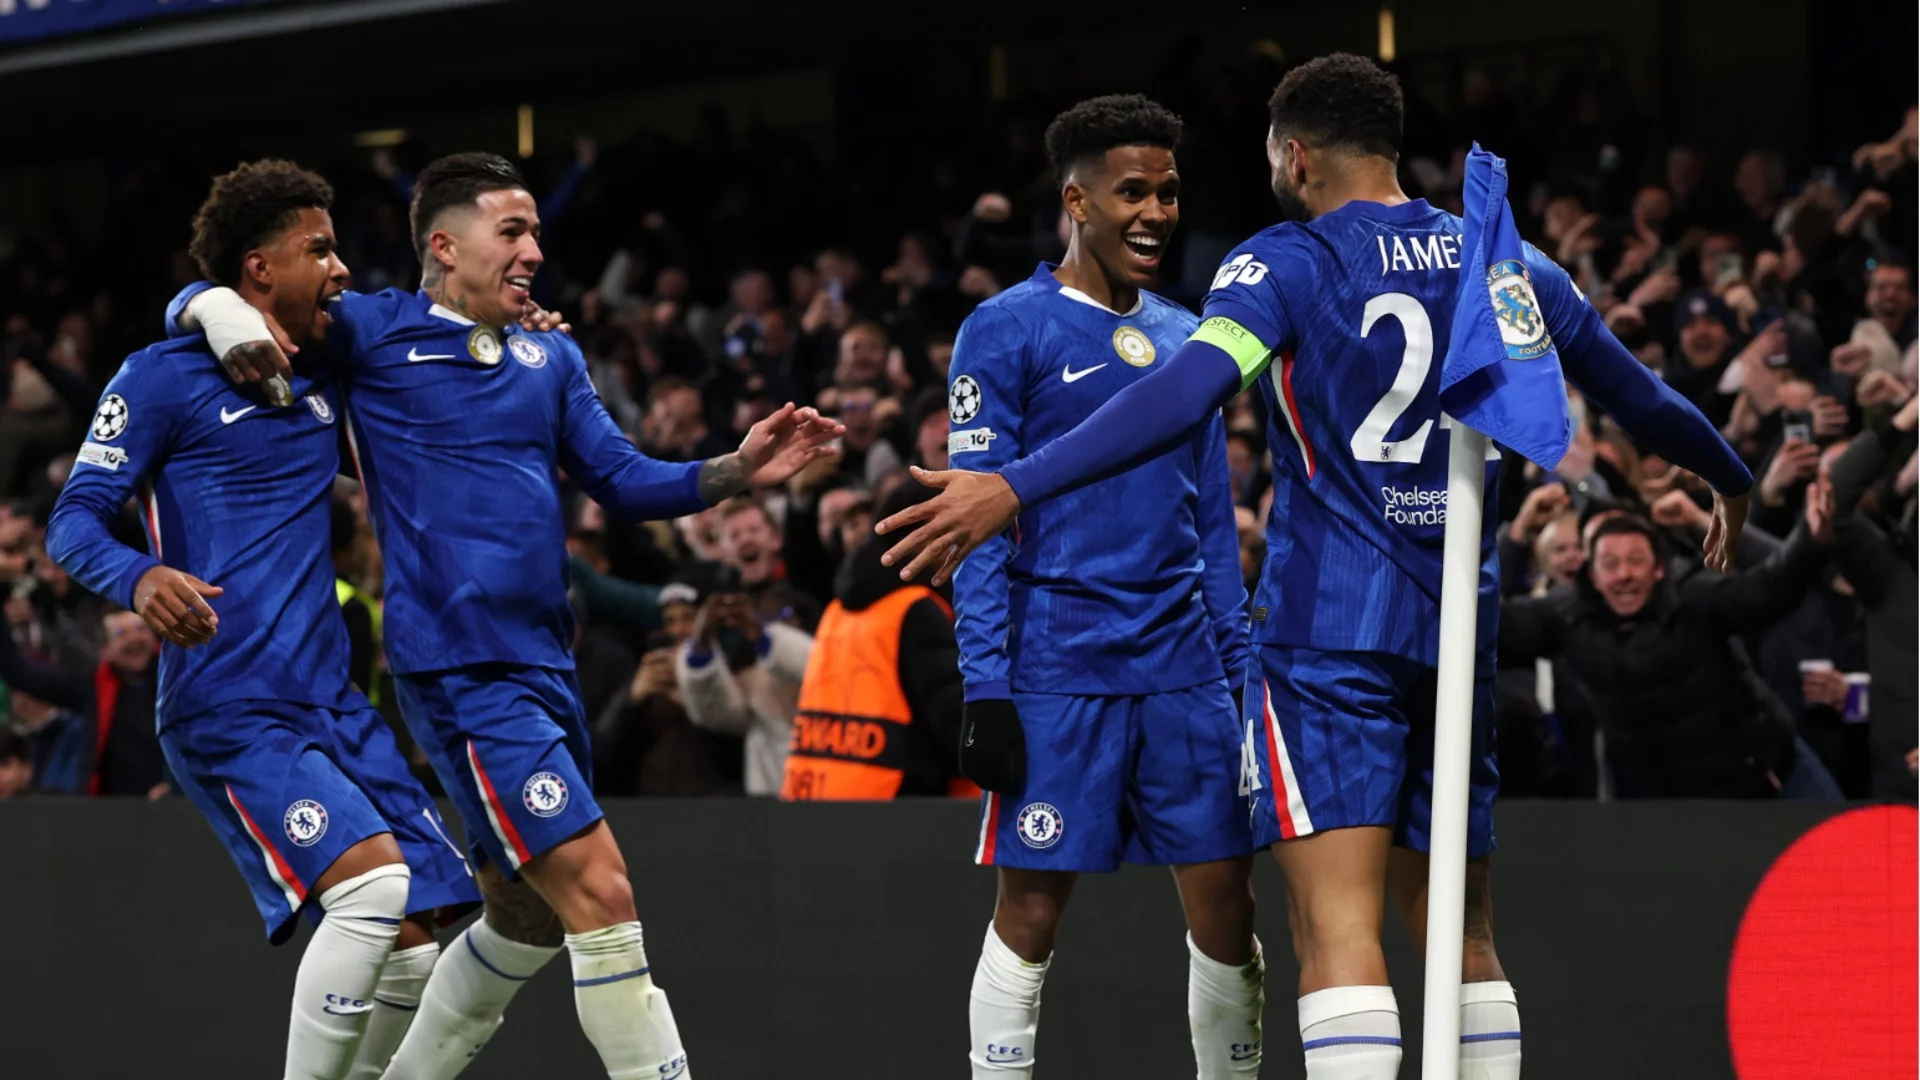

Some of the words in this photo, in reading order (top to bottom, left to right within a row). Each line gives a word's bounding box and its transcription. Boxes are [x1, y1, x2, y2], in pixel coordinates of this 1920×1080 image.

[1350, 292, 1502, 464] 2
[1381, 485, 1448, 506] Chelsea
[1384, 504, 1447, 525] Founda
[791, 715, 887, 758] EWARD
[525, 773, 552, 791] CHELSEA
[1025, 803, 1056, 815] CHELSEA
[987, 1043, 1023, 1056] CFC
